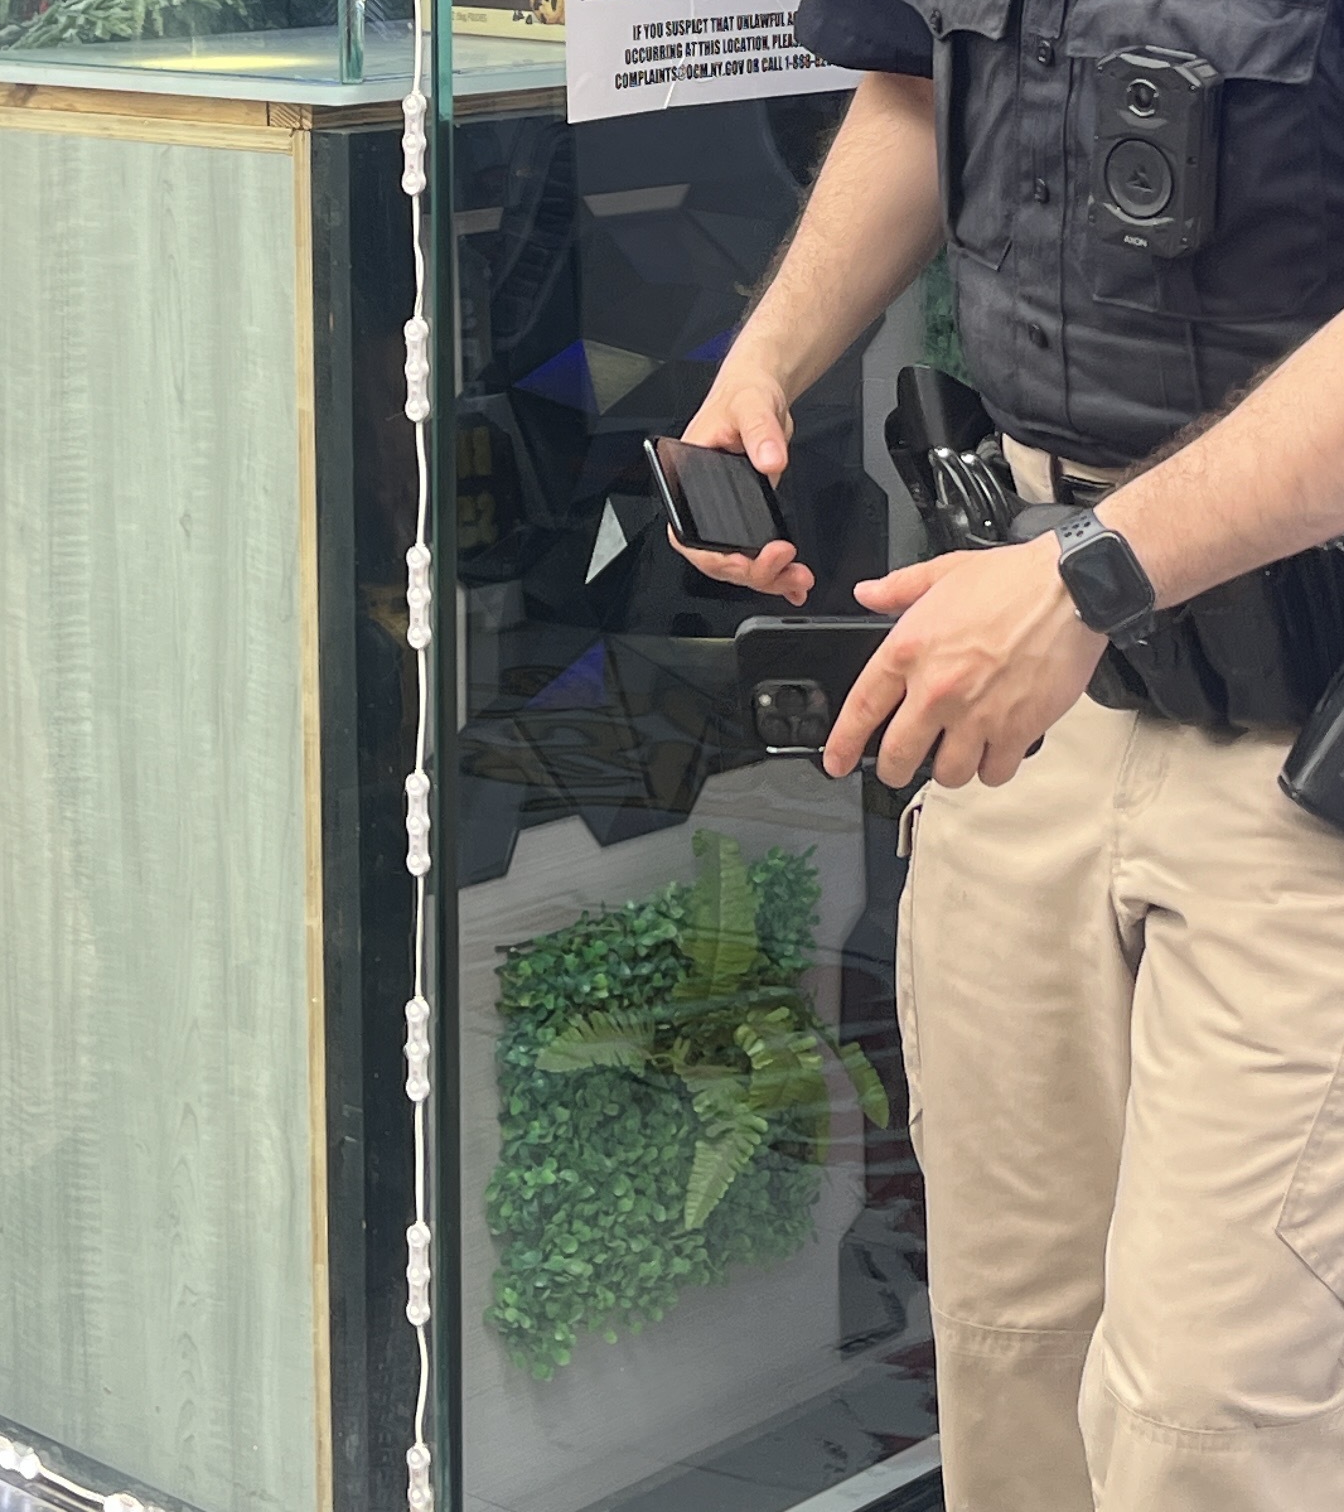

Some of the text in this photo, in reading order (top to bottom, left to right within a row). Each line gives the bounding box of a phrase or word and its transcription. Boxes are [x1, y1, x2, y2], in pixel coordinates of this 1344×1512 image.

[632, 24, 643, 41] IF
[644, 22, 663, 39] YOU
[710, 15, 734, 33] THAT
[736, 11, 785, 31] UNLAWFUL
[624, 42, 683, 65] OCCURRING
[685, 42, 696, 58] AT
[697, 39, 721, 57] THIS
[747, 57, 759, 74] OR
[761, 54, 784, 72] CALL
